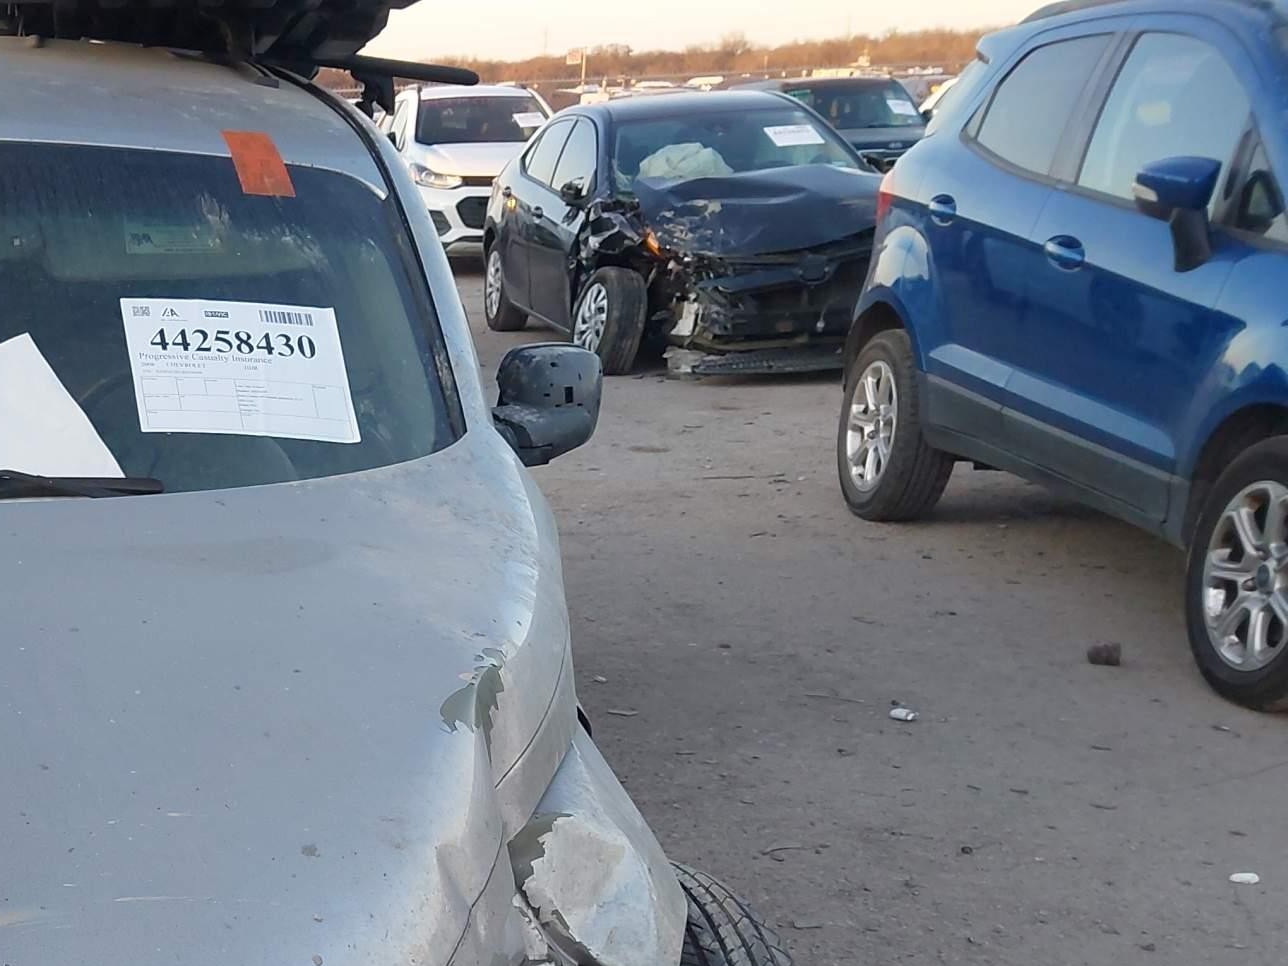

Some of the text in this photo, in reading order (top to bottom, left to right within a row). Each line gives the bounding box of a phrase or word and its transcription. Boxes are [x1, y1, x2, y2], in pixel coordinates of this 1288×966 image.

[150, 327, 316, 359] 44258430
[138, 352, 273, 365] Progressive Casualty Insurance
